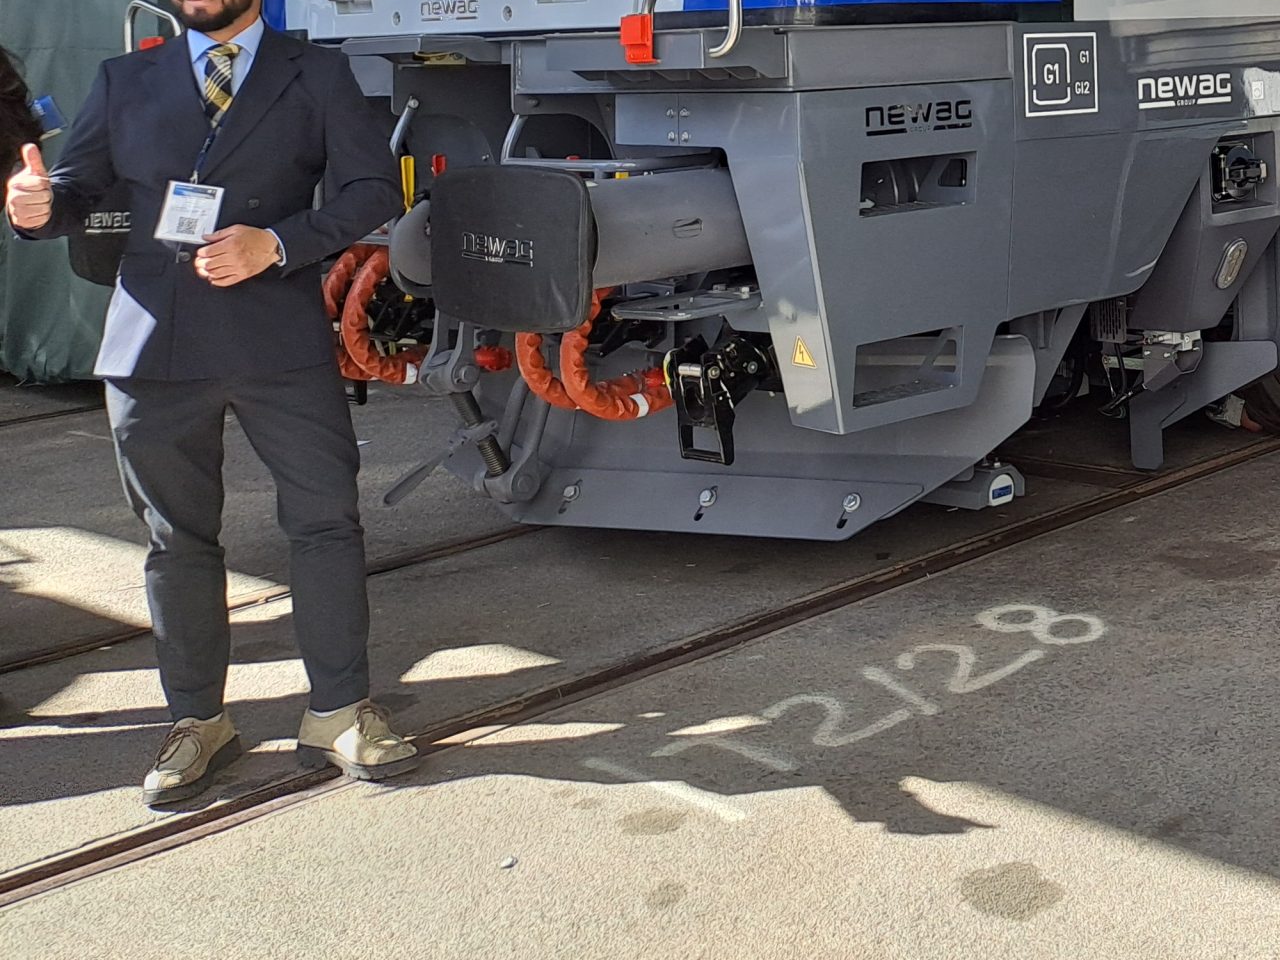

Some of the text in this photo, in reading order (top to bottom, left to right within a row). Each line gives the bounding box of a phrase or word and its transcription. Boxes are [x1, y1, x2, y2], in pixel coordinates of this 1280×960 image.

[1079, 50, 1091, 64] G1
[1043, 63, 1061, 85] G1
[1176, 99, 1196, 107] GROUP
